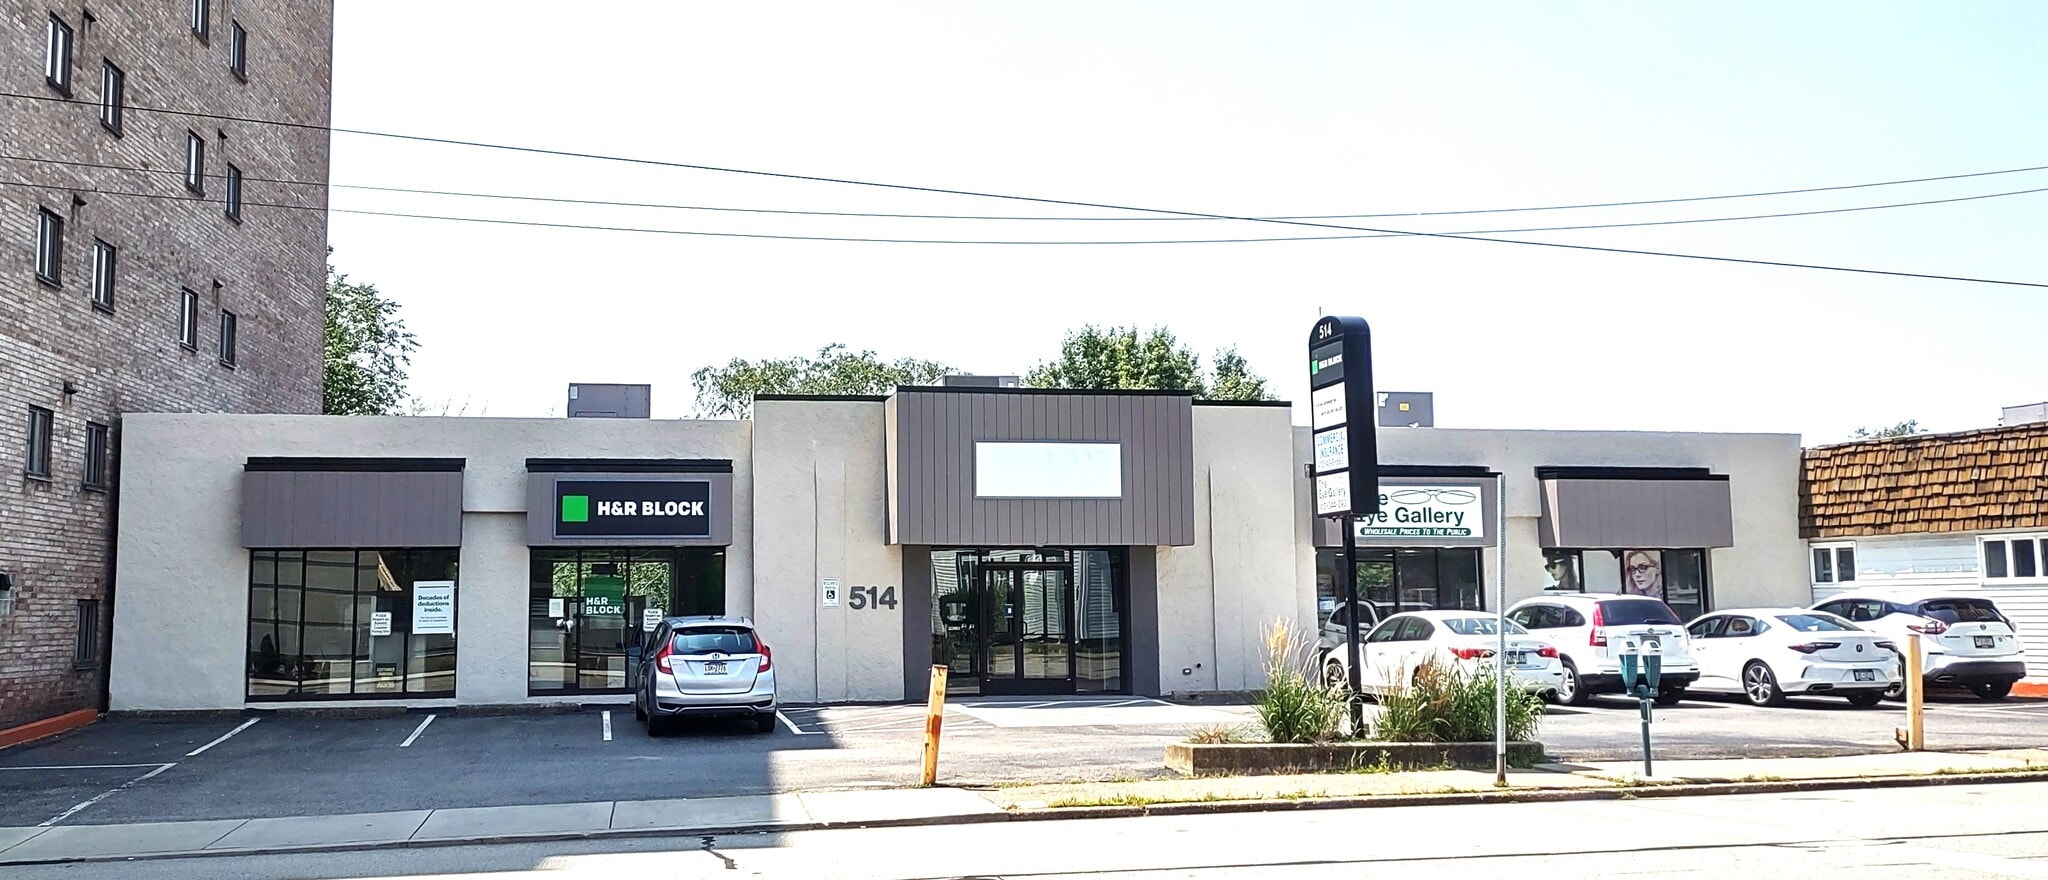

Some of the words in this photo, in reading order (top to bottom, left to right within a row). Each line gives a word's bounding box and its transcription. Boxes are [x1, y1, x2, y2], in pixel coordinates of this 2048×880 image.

[1319, 322, 1332, 339] 514
[597, 501, 637, 516] H&R
[641, 501, 704, 516] BLOCK
[1395, 506, 1464, 527] Gallery
[1364, 528, 1397, 536] WHOLESALE
[1399, 528, 1420, 536] PRICES
[1446, 528, 1468, 536] PUBLIC
[586, 597, 608, 605] H&R
[849, 586, 898, 610] 514
[586, 606, 621, 614] BLOCK
